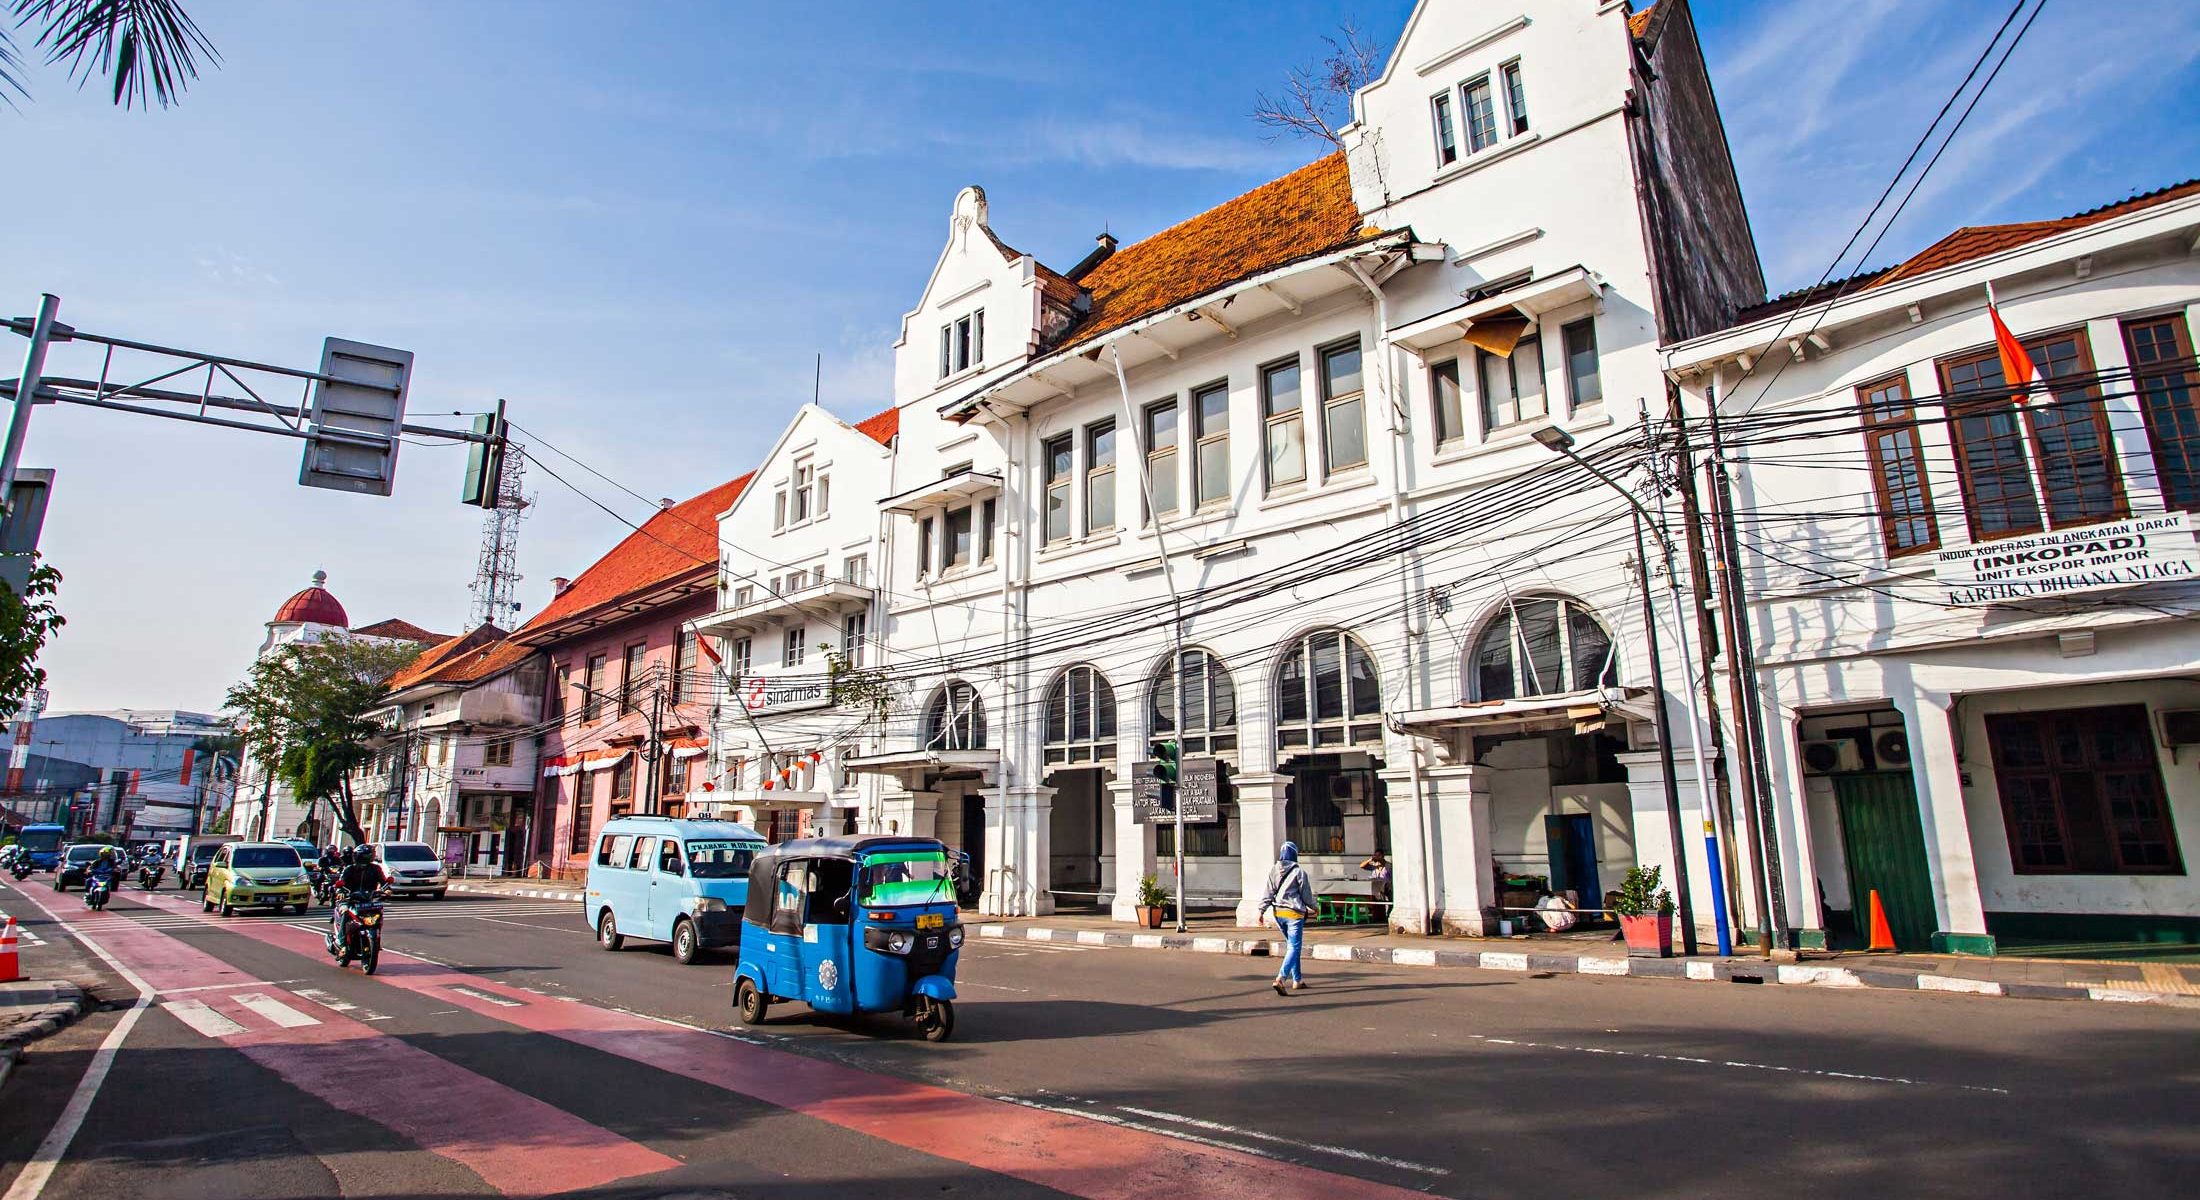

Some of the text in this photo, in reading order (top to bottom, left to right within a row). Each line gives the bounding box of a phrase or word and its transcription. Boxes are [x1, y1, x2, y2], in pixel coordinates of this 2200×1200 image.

[1939, 549, 1973, 562] INDUK
[1976, 539, 2036, 556] KOPERASI
[2063, 525, 2131, 544] ANGKATAN
[2135, 516, 2179, 532] DARAT
[1973, 534, 2147, 572] (INKOPAD)
[1949, 559, 2193, 605] KARTIKA BHUANA NIAGA
[1975, 549, 2151, 583] UNIT EKSPOR IMPOR
[766, 686, 821, 706] sinarmas
[819, 827, 824, 837] 8
